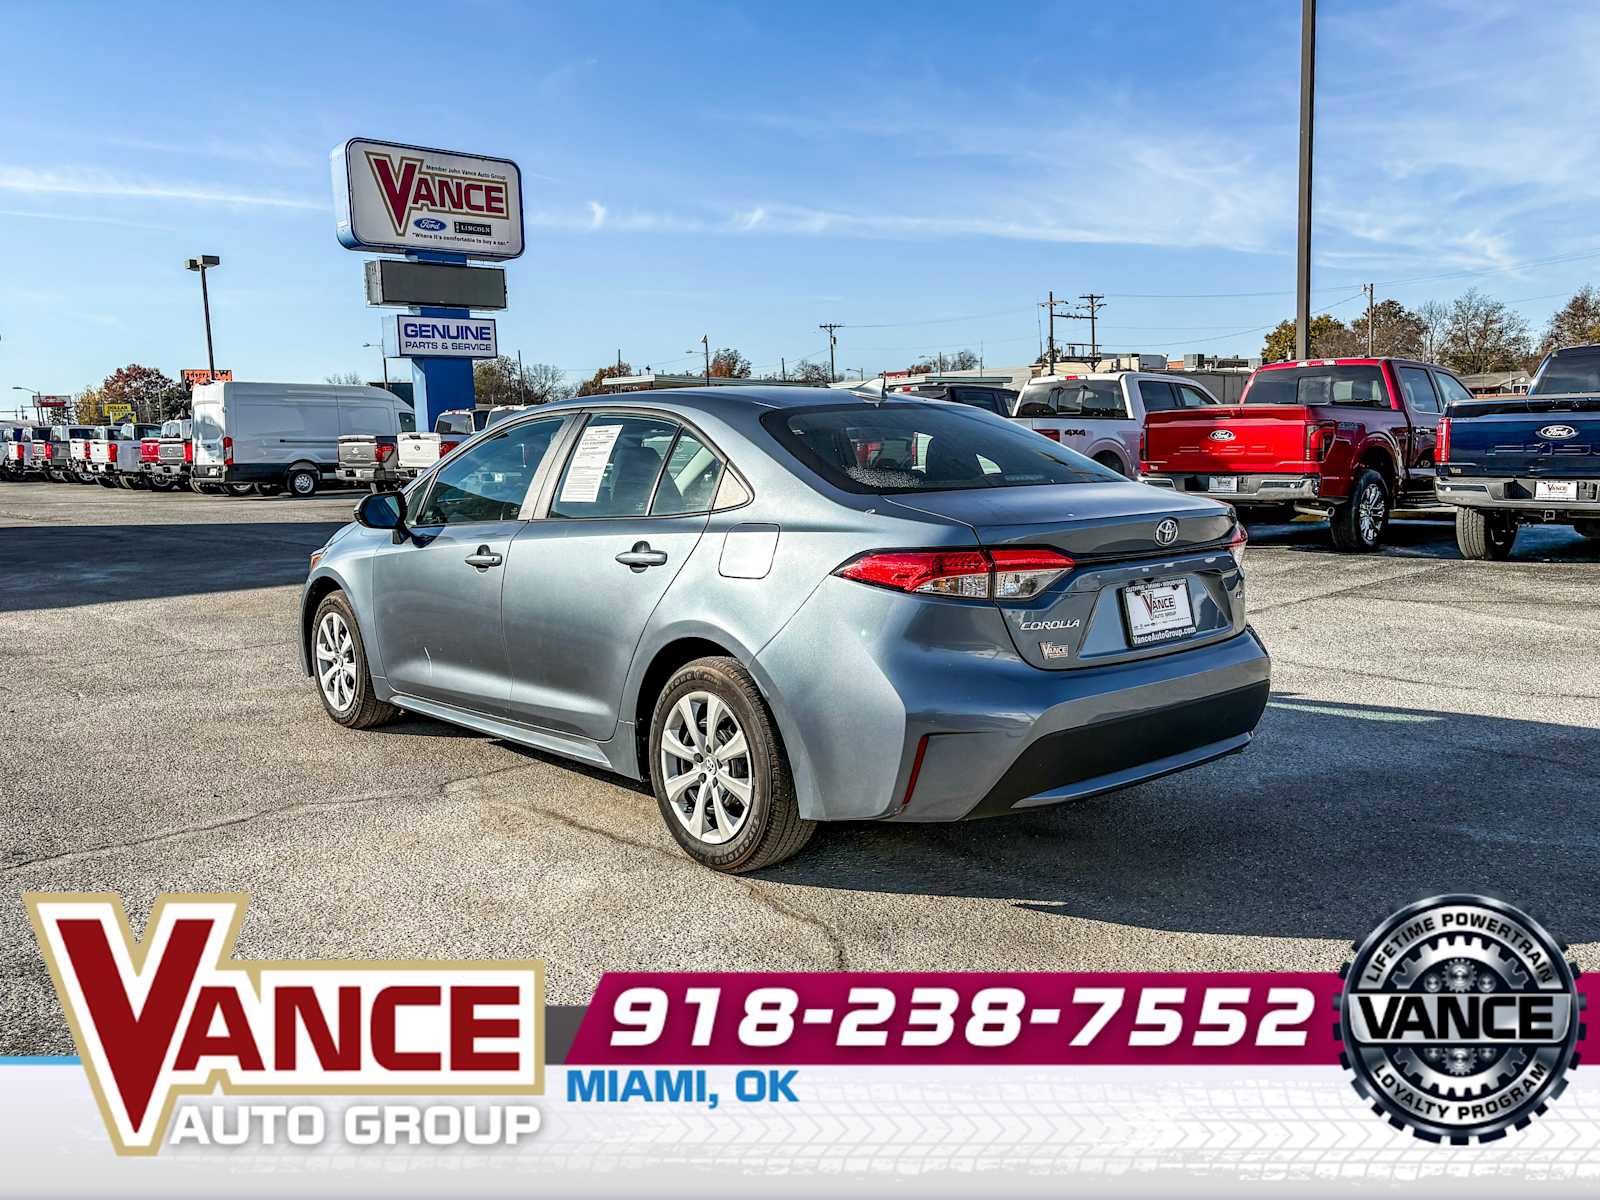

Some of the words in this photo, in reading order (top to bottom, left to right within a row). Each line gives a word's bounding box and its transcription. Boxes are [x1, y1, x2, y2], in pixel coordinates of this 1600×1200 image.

[426, 164, 447, 173] Member
[461, 169, 477, 177] Vance
[491, 173, 506, 181] Group
[367, 154, 508, 235] VANCE
[460, 224, 490, 234] LINCOLN
[403, 323, 492, 341] GENUINE
[405, 341, 438, 350] PARTS
[441, 342, 449, 350] &
[451, 342, 492, 352] SERVICE
[1141, 590, 1175, 620] VANCE
[1020, 618, 1080, 631] COROLLA
[1132, 626, 1197, 645] VanceAutoGroup.com
